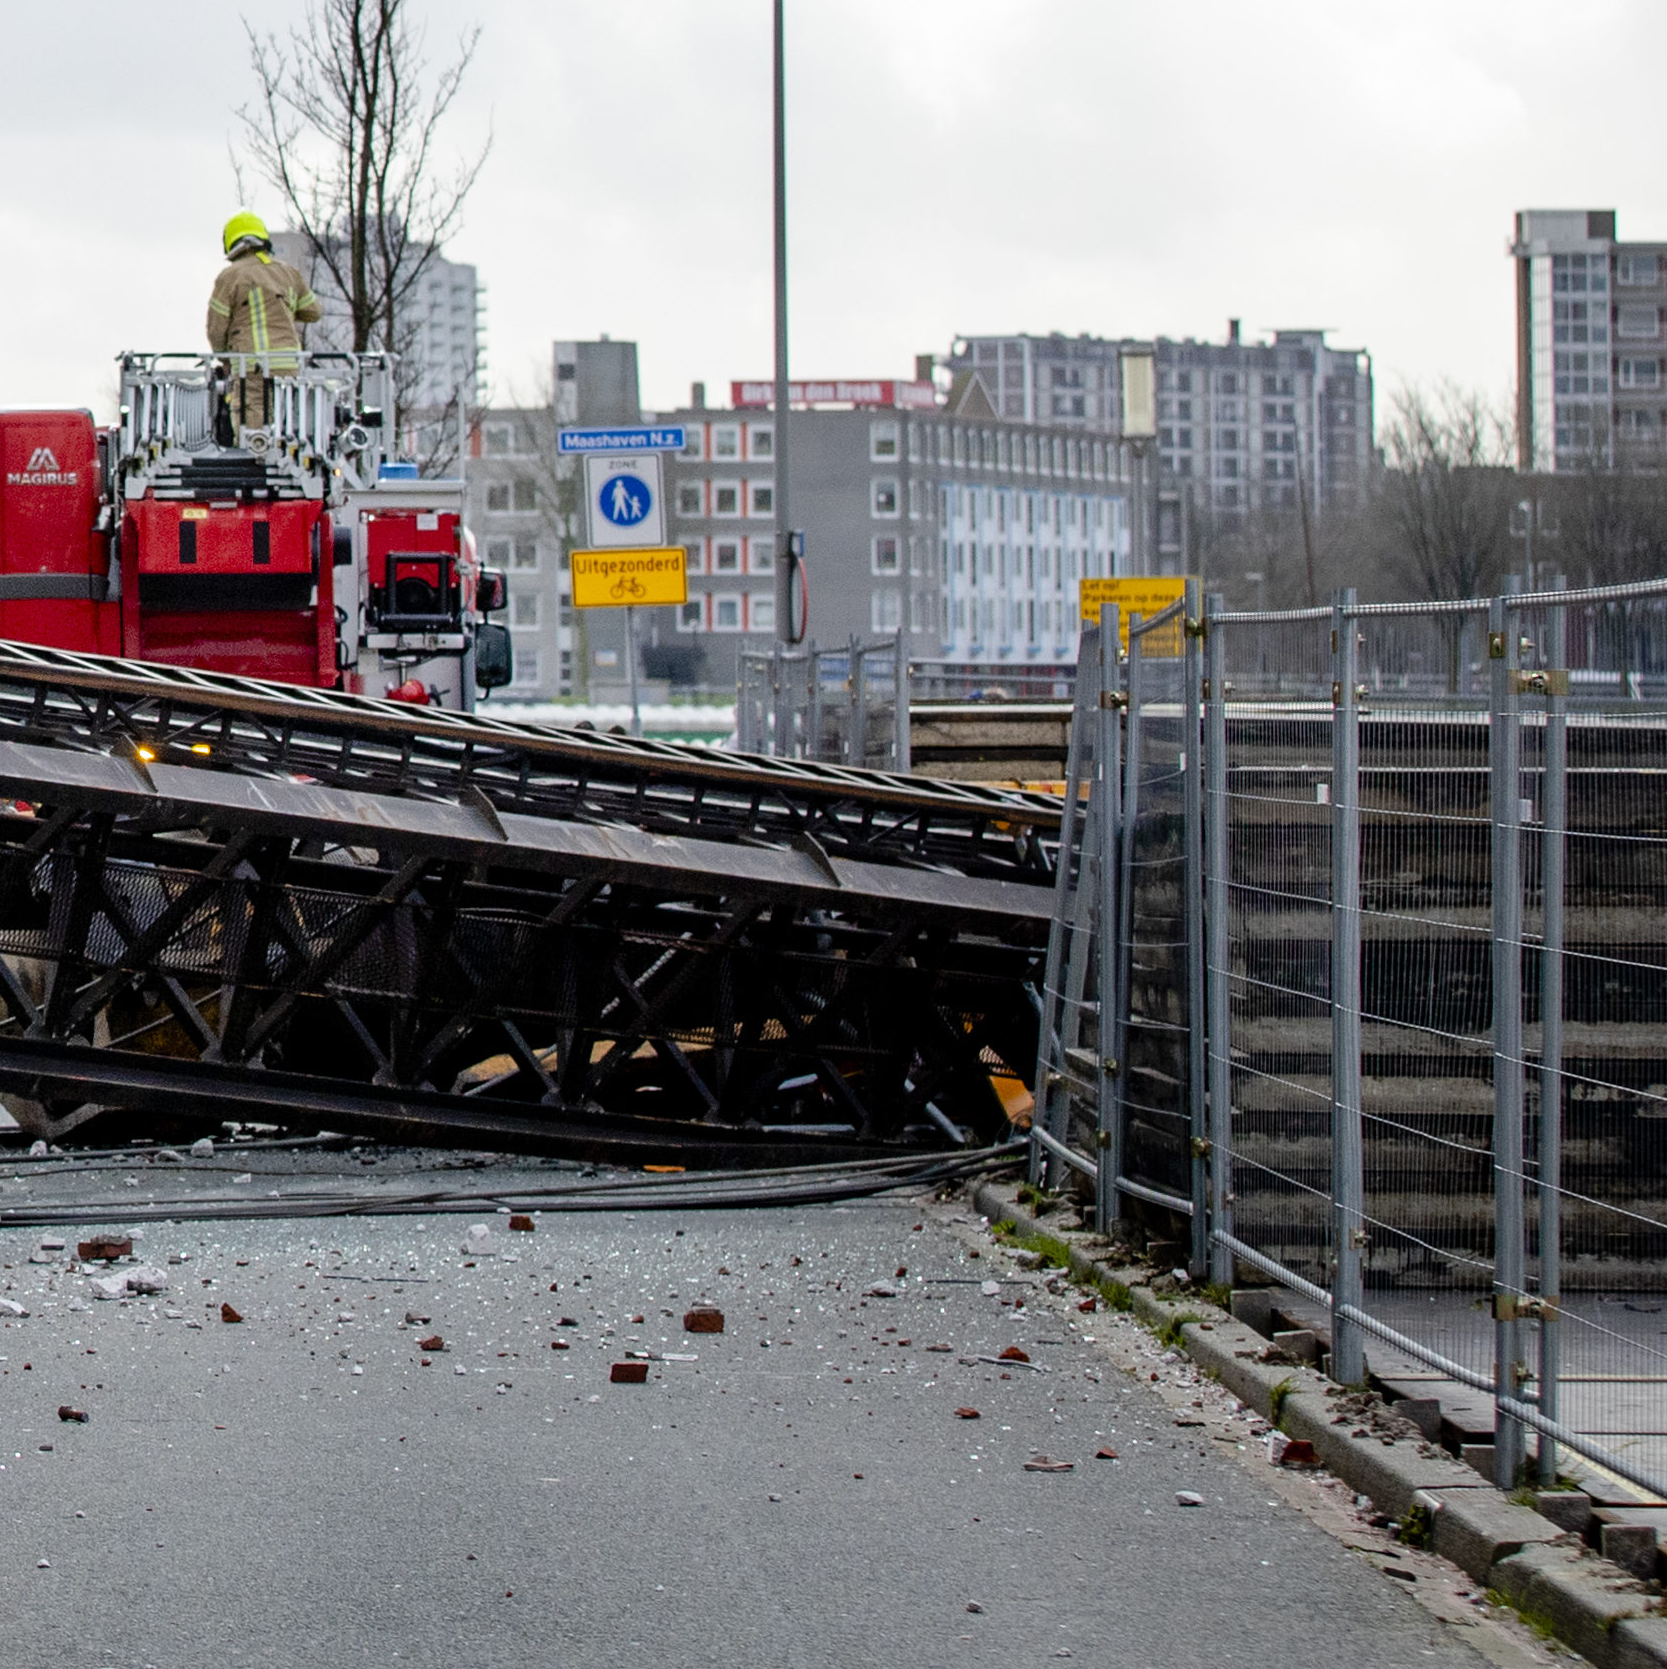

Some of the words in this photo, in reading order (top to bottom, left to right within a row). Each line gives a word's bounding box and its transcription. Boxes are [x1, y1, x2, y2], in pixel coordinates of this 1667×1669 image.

[565, 434, 647, 448] Maashaven
[7, 473, 77, 485] MAGIRUS
[576, 557, 680, 577] Uitgezonderd
